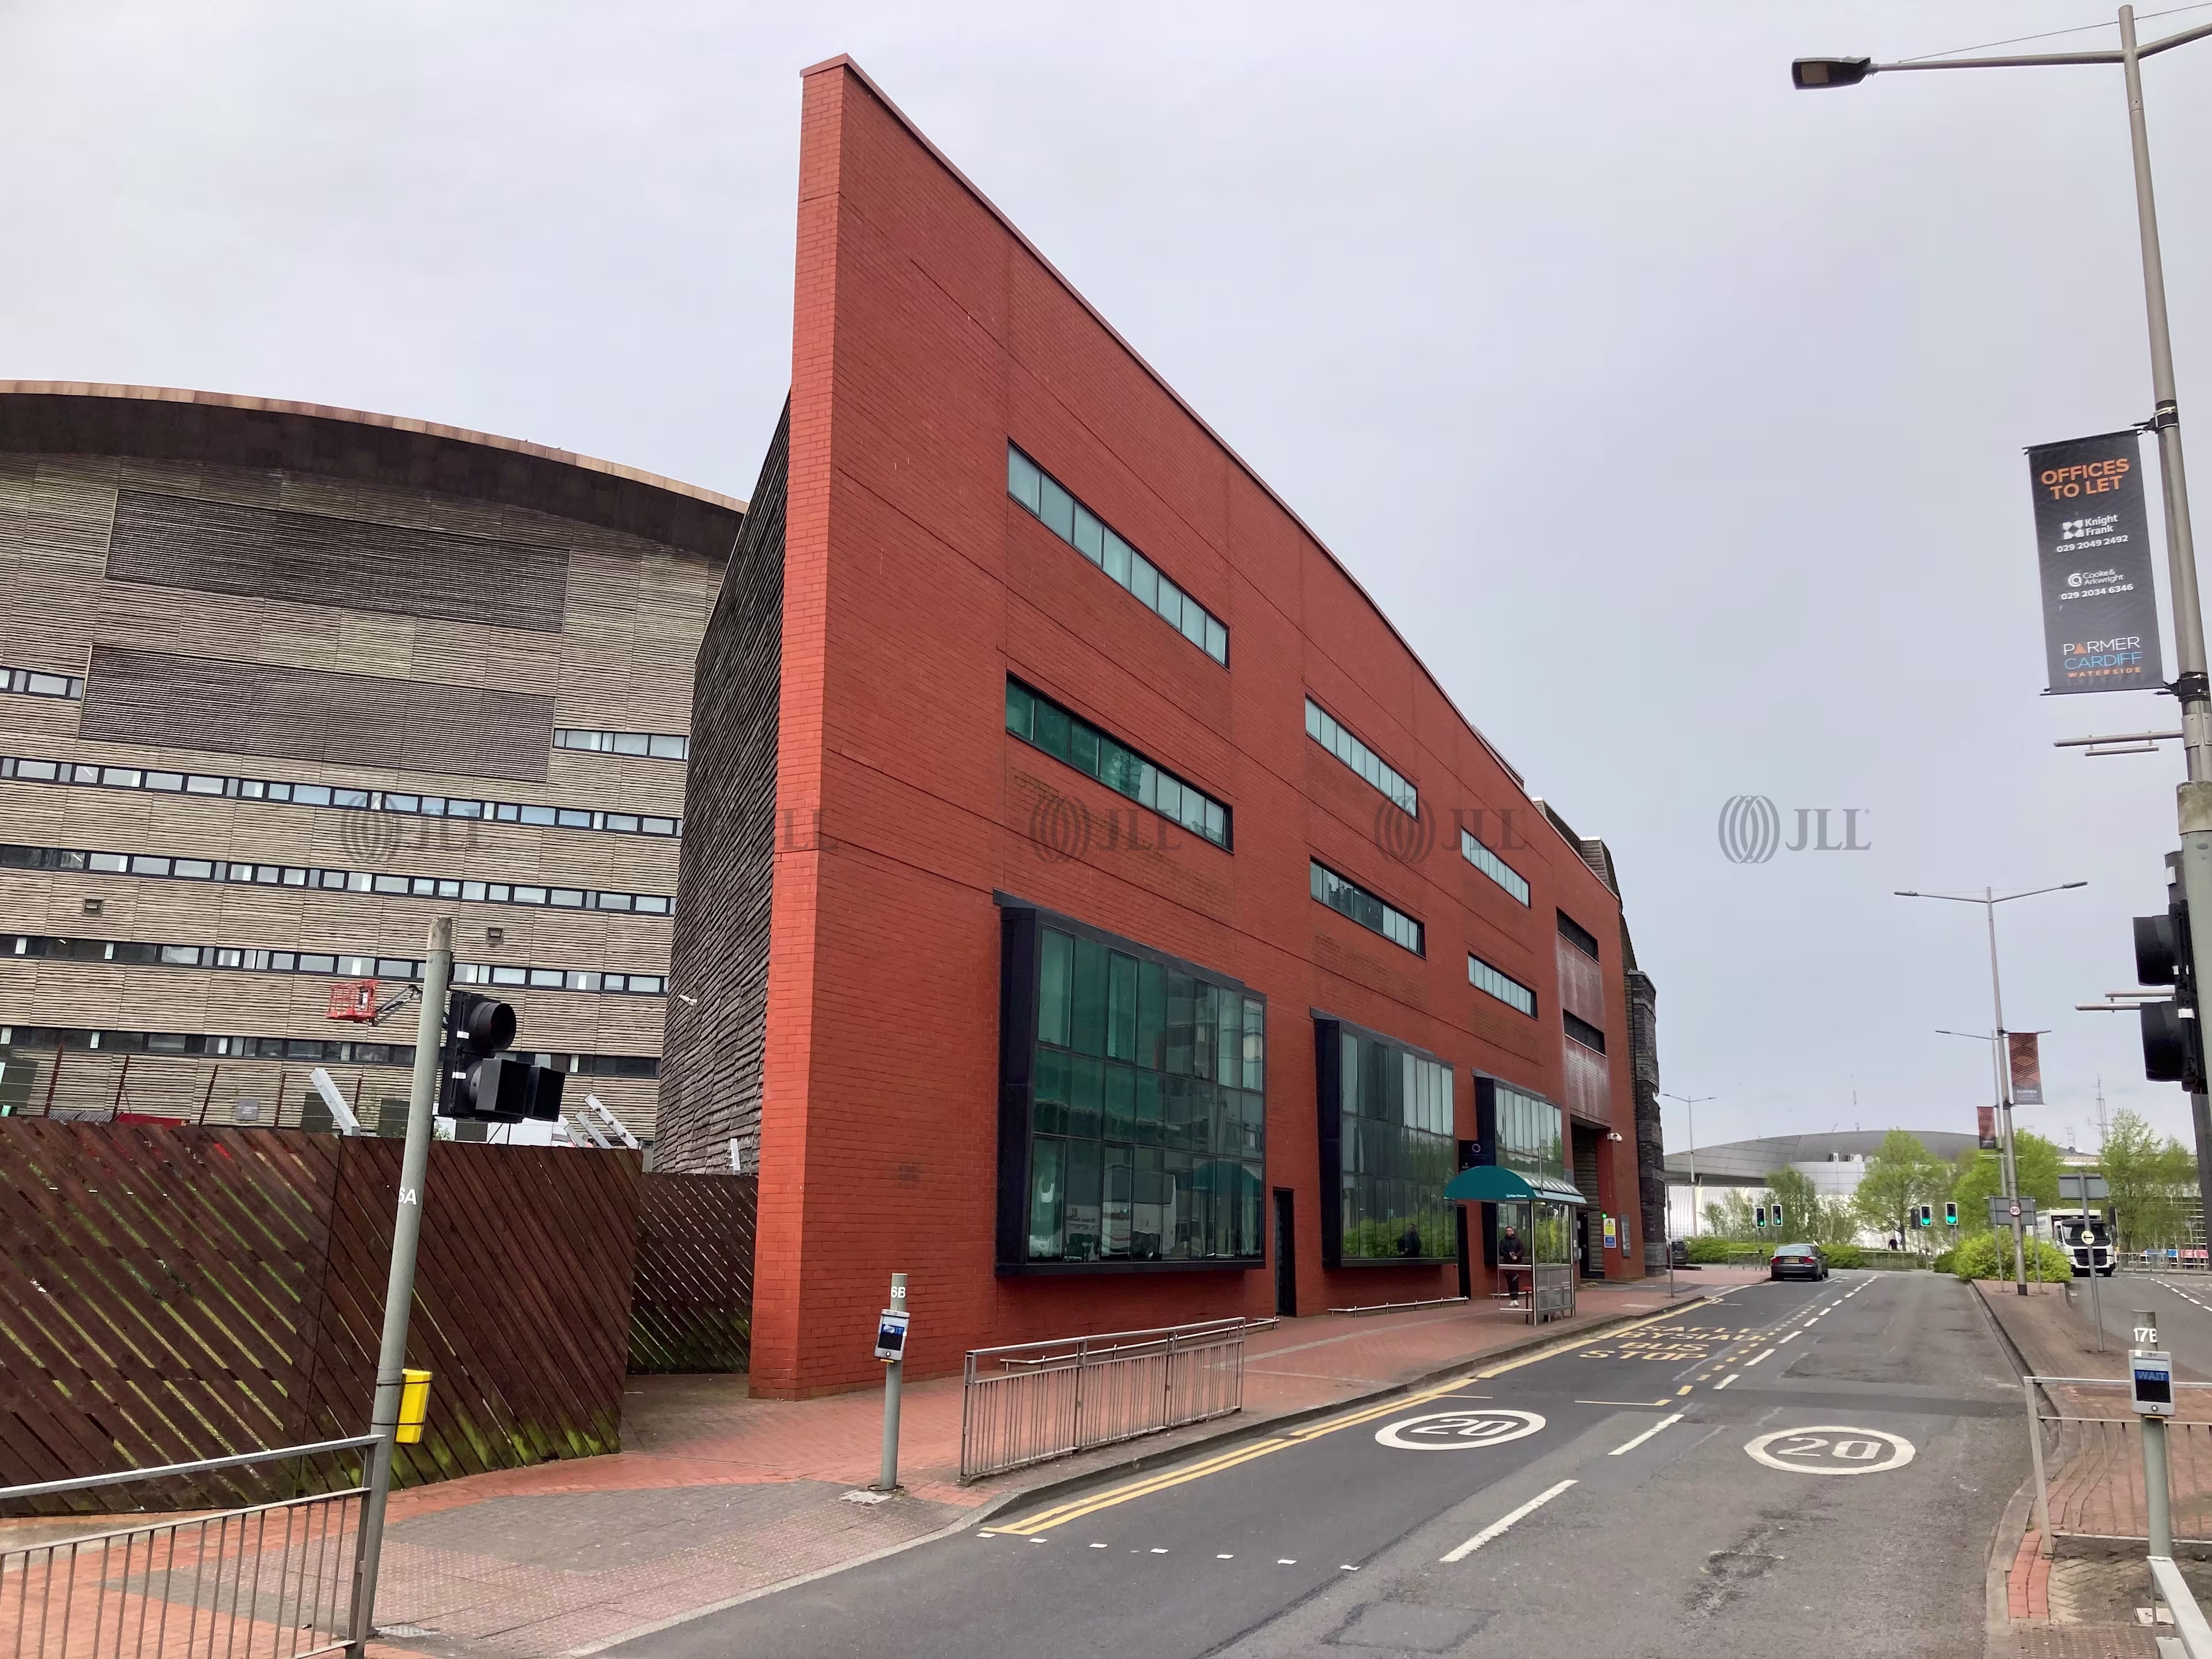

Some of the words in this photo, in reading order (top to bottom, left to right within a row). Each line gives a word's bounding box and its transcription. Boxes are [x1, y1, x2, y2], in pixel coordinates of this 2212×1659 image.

[2041, 458, 2130, 484] OFFICES
[2050, 483, 2080, 500] TO
[2085, 475, 2123, 494] LET
[2085, 514, 2118, 527] Knight
[2086, 525, 2114, 536] Frank
[2056, 543, 2075, 552] 029
[2077, 539, 2102, 550] 2049
[2104, 535, 2128, 546] 2492
[2084, 574, 2124, 586] Arkwright
[2061, 592, 2080, 600] 029
[2081, 588, 2107, 598] 2034
[2108, 584, 2134, 594] 6346
[2065, 652, 2142, 669] CARDIFF
[2068, 666, 2142, 678] WATERSIDE
[398, 1187, 417, 1205] 6A
[891, 1286, 906, 1298] 6B
[2133, 1327, 2158, 1343] 17B
[1618, 1342, 1709, 1351] BUS
[1579, 1350, 1708, 1361] STOP
[2138, 1371, 2166, 1381] WAIT
[1410, 1419, 1518, 1436] 20
[1777, 1438, 1881, 1459] 20
